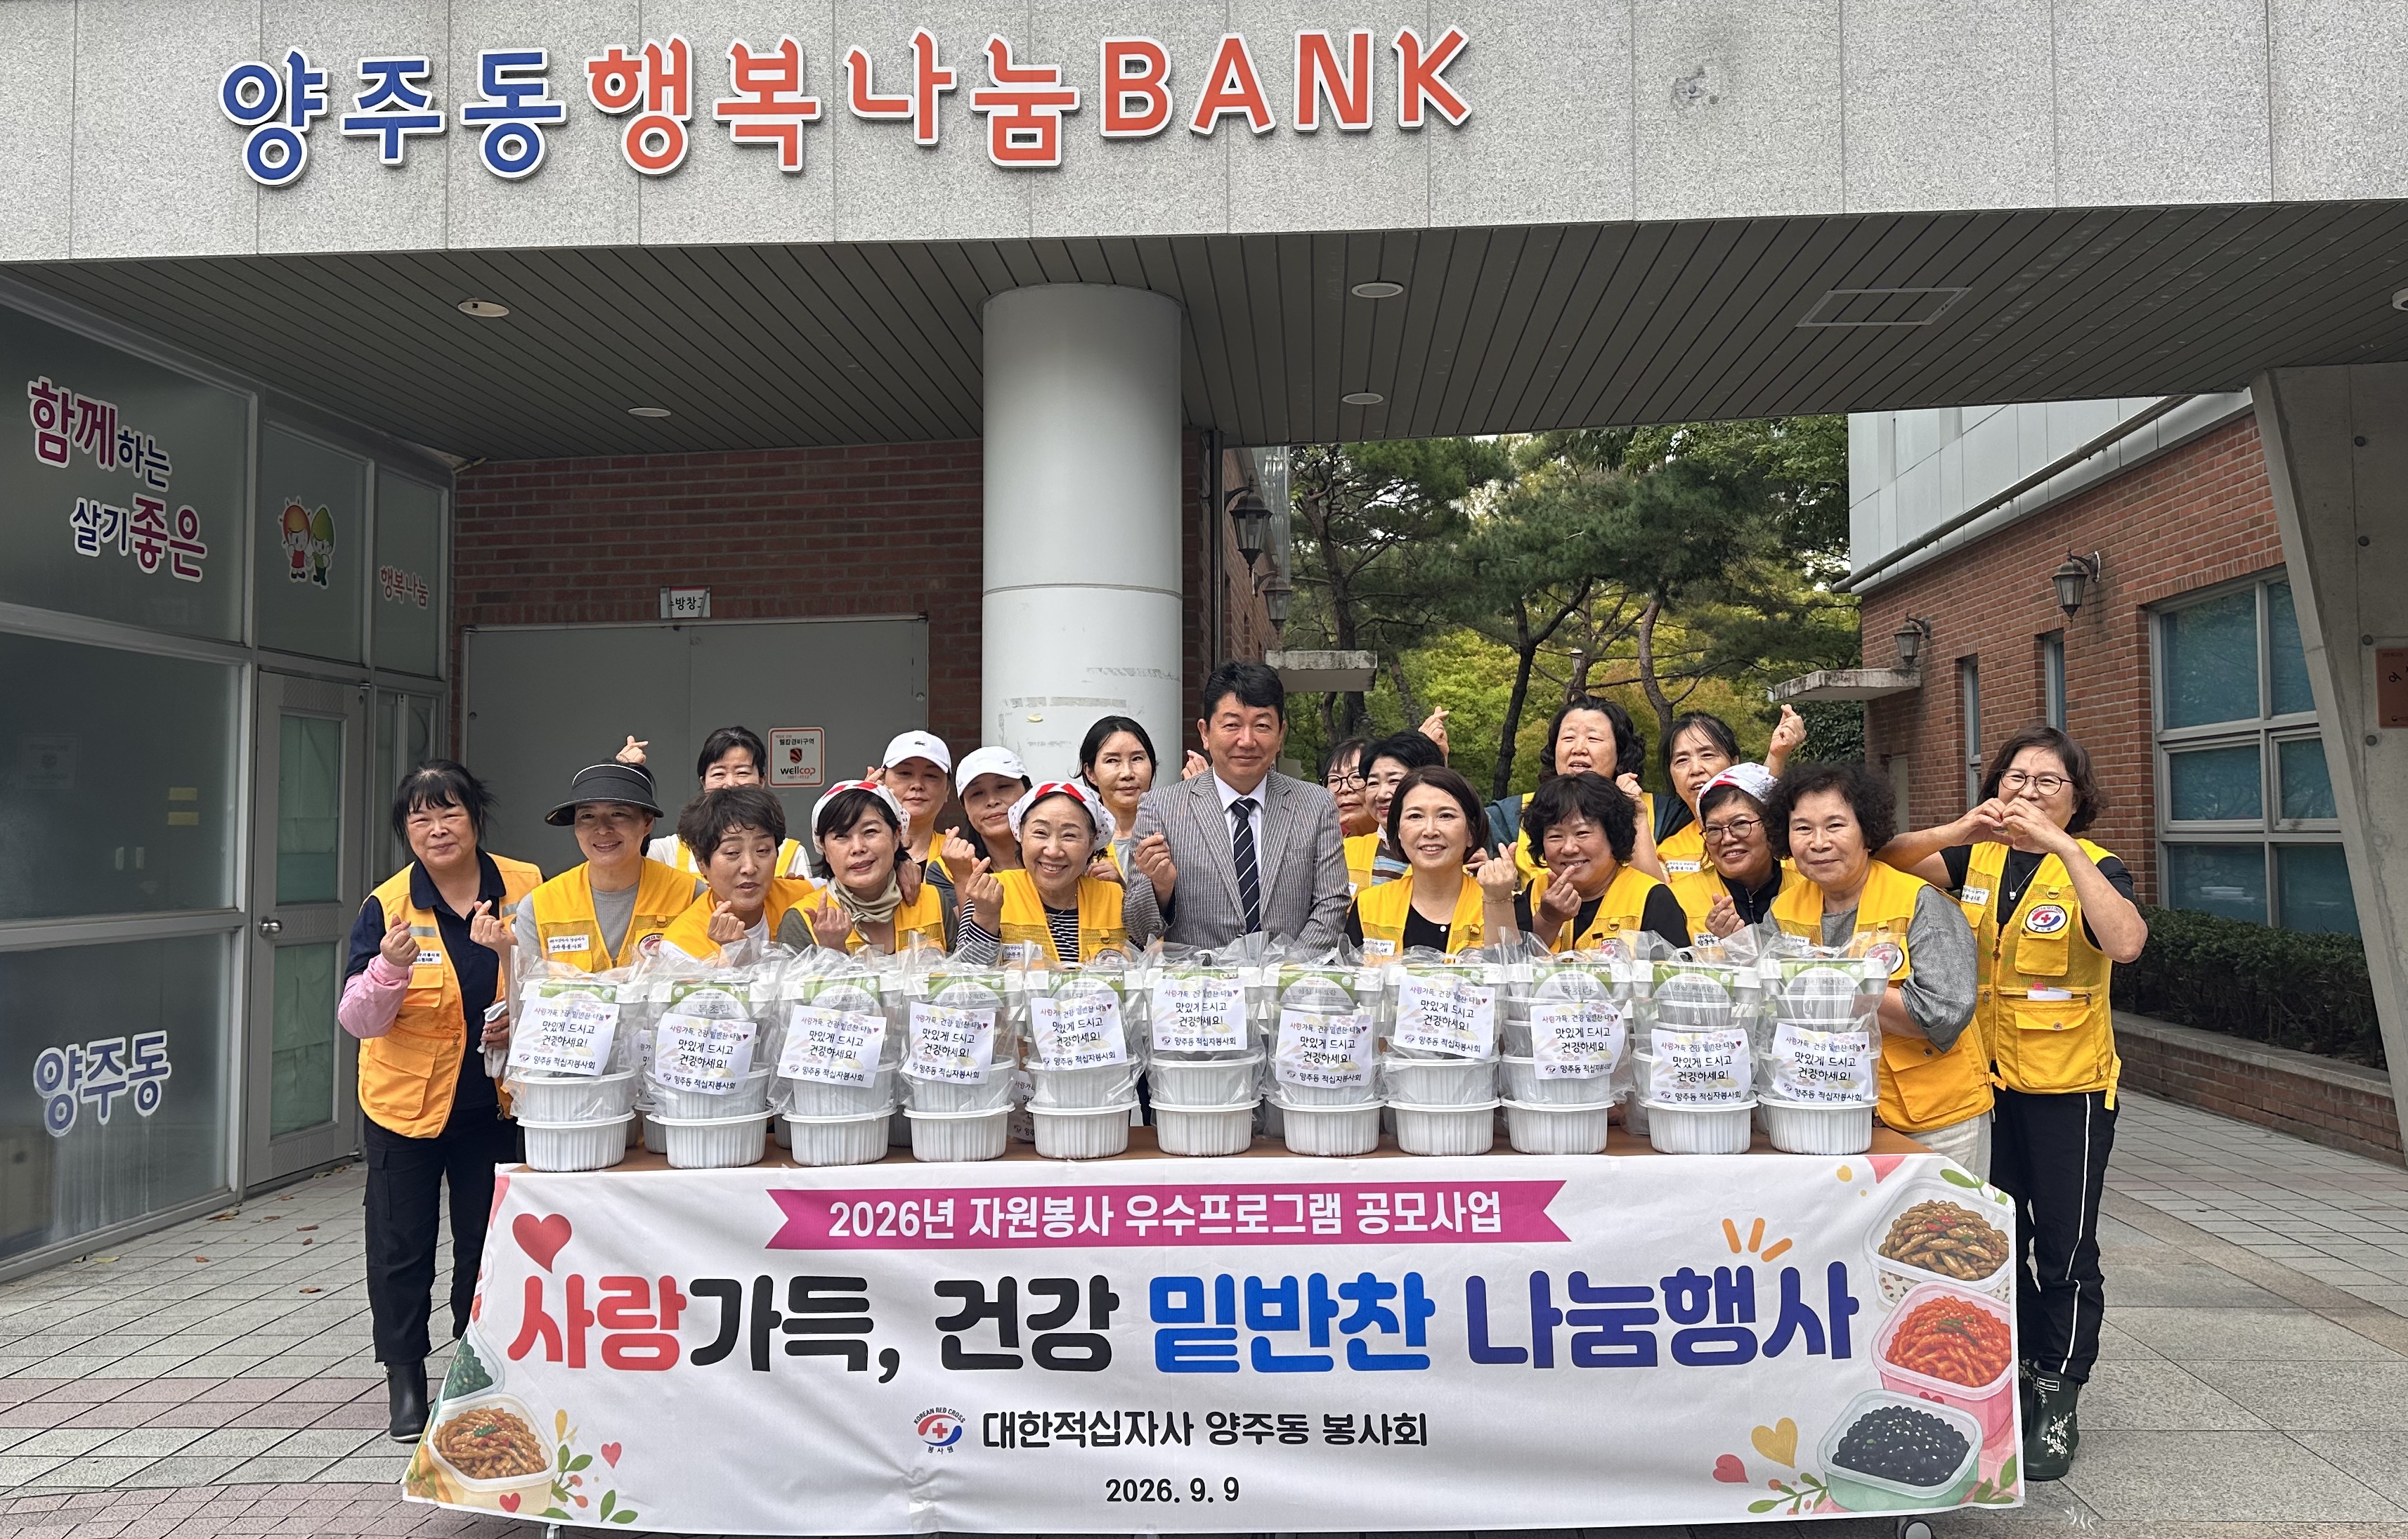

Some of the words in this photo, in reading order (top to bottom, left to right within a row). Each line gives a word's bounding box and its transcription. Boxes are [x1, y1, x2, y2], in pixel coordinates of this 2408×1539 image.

[29, 377, 171, 492] 함께하는
[1202, 1003, 1228, 1012] 드시고
[1421, 1000, 1448, 1013] 맛있게
[1452, 1005, 1474, 1018] 드시고
[542, 1021, 566, 1032] 맛있게
[568, 1023, 594, 1034] 드시고
[1053, 1022, 1074, 1033] 맛있게
[1078, 1018, 1103, 1028] 드시고
[1179, 1016, 1223, 1027] 건강하세요!
[1424, 1015, 1469, 1032] 건강하세요!
[809, 1031, 835, 1044] 맛있게
[837, 1036, 864, 1046] 드시고
[923, 1029, 949, 1042] 맛있게
[952, 1033, 975, 1044] 드시고
[1057, 1032, 1100, 1047] 건강하세요!
[1556, 1027, 1584, 1039] 맛있게
[1587, 1028, 1610, 1037] 드시고
[542, 1035, 587, 1048] 건강하세요!
[678, 1039, 704, 1053] 맛있게
[707, 1044, 733, 1055] 드시고
[1174, 1037, 1194, 1046] 양주동
[1197, 1037, 1236, 1046] 적십자봉사회
[1301, 1037, 1326, 1048] 맛있게
[1330, 1039, 1355, 1049] 드시고
[1419, 1037, 1438, 1046] 양주동
[1441, 1039, 1480, 1053] 적십자봉사회
[1562, 1042, 1607, 1053] 건강하세요!
[809, 1045, 856, 1060] 건강하세요!
[925, 1043, 969, 1058] 건강하세요!
[1054, 1057, 1073, 1065] 양주동
[1075, 1051, 1115, 1064] 적십자봉사회
[1303, 1051, 1351, 1064] 건강하세요!
[554, 1058, 595, 1069] 적십자봉사회
[679, 1054, 727, 1069] 건강하세요!
[1673, 1056, 1701, 1067] 맛있게
[1705, 1056, 1732, 1067] 드시고
[1795, 1051, 1824, 1066] 맛있게
[1828, 1058, 1856, 1067] 드시고
[802, 1066, 821, 1075] 양주동
[823, 1069, 864, 1082] 적십자봉사회
[920, 1065, 937, 1075] 양주동
[939, 1068, 980, 1079] 적십자봉사회
[1560, 1065, 1581, 1074] 양주동
[1678, 1070, 1729, 1082] 건강하세요!
[1798, 1067, 1850, 1082] 건강하세요!
[34, 1031, 171, 1137] 양주동
[675, 1076, 691, 1086] 양주동
[694, 1079, 736, 1090] 적십자봉사회
[1300, 1073, 1319, 1082] 양주동
[1322, 1074, 1361, 1084] 적십자봉사회
[1675, 1093, 1697, 1101] 양주동
[1700, 1091, 1740, 1100] 적십자봉사회
[1795, 1089, 1815, 1098] 양주동
[1818, 1091, 1861, 1102] 적십자봉사회
[828, 1197, 954, 1240] 2026년
[969, 1195, 1114, 1238] 자원봉사
[1126, 1193, 1341, 1237] 우수프로그램
[1355, 1190, 1502, 1234] 공모사업
[507, 1274, 900, 1384] 사랑가득,
[934, 1274, 1120, 1372] 건강
[1149, 1272, 1436, 1373] 밑반찬
[1465, 1261, 1860, 1369] 나눔행사
[913, 1408, 935, 1425] KOREAN
[948, 1408, 965, 1423] CROSS
[983, 1410, 1195, 1448] 대한적십자사
[1206, 1410, 1310, 1446] 양주동
[1322, 1412, 1428, 1446] 봉사회
[1105, 1478, 1180, 1503] 2026.
[1190, 1477, 1214, 1503] 9.
[1223, 1476, 1239, 1502] 9
